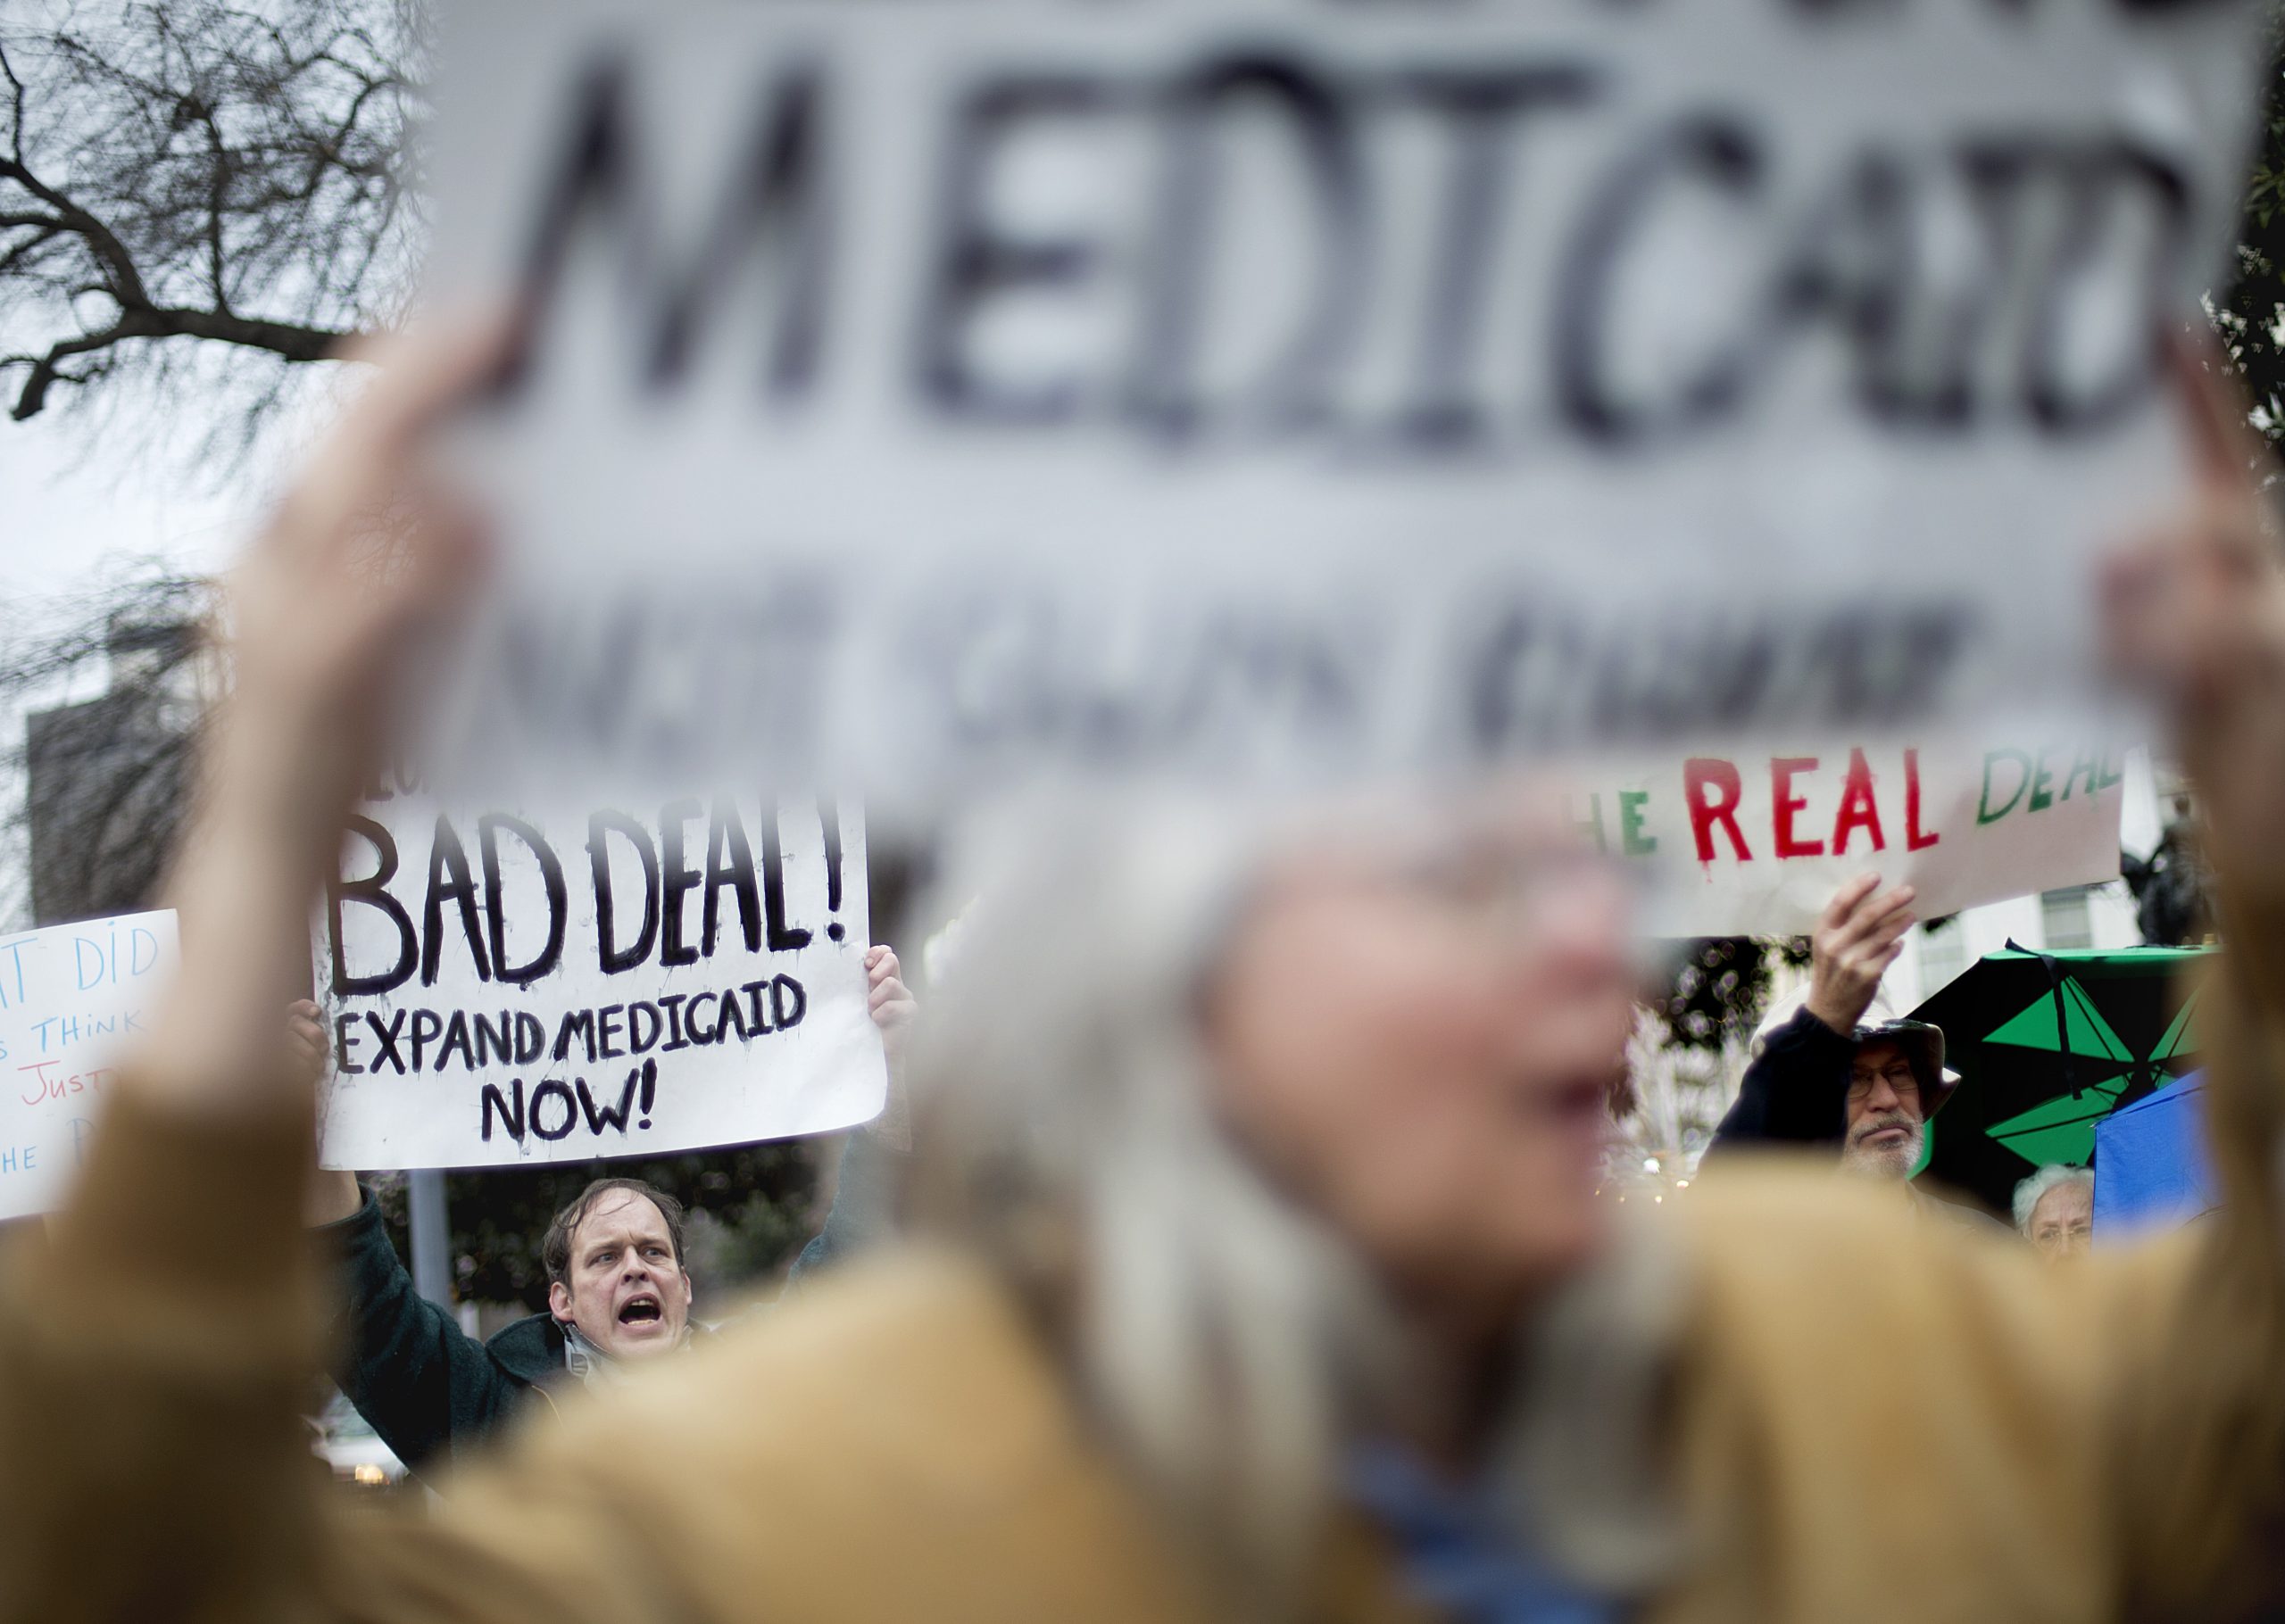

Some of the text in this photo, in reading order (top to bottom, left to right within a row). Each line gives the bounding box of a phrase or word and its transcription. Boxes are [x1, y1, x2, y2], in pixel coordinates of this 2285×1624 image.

[1561, 746, 2122, 861] HE REAL DEAL
[327, 787, 845, 997] BAD DEAL!
[335, 974, 807, 1076] EXPAND MEDICAID
[480, 1056, 659, 1143] NOW!
